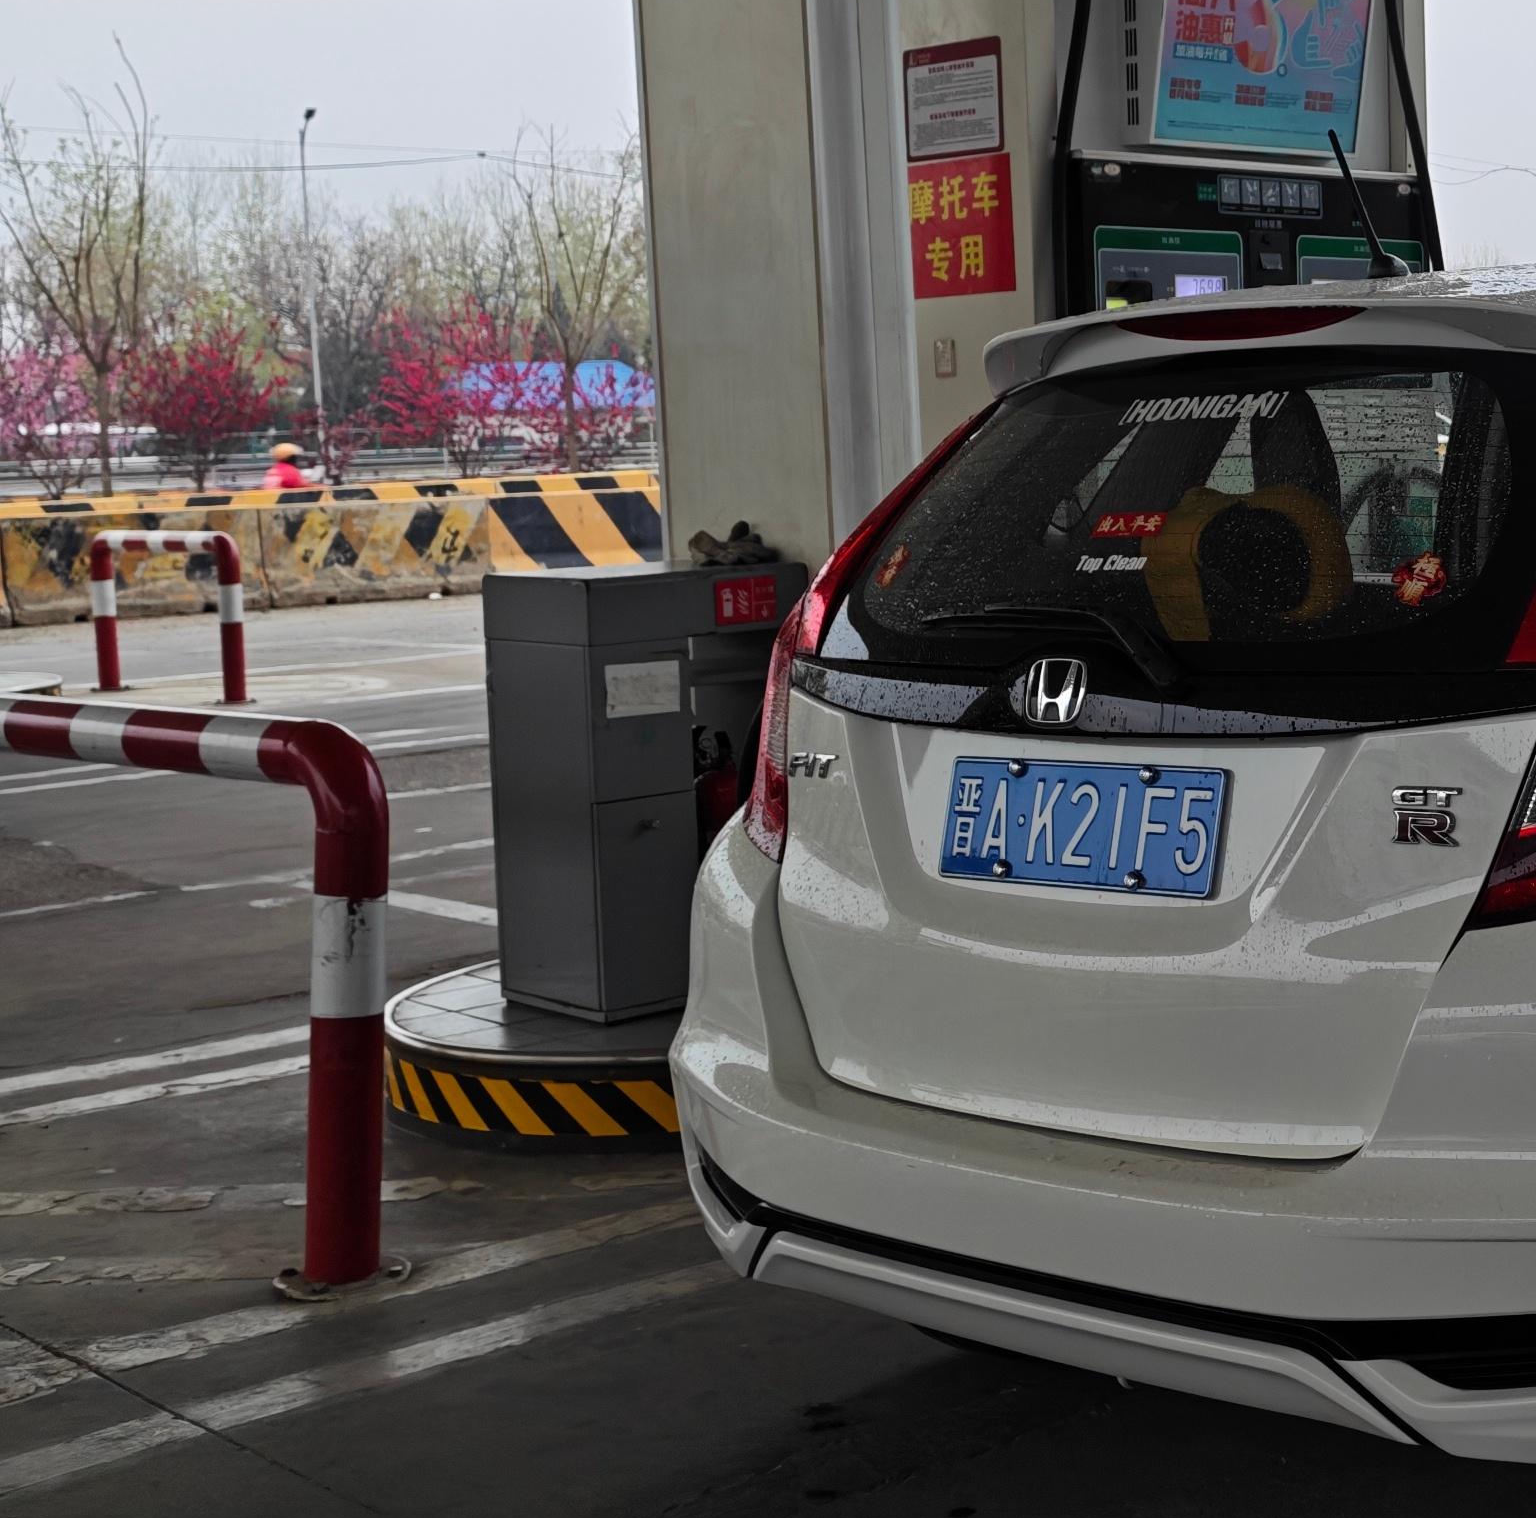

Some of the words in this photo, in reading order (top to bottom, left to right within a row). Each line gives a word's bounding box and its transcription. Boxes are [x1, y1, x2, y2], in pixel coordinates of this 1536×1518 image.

[908, 170, 1000, 226] 摩托车
[925, 234, 986, 282] 专用
[1096, 514, 1162, 532] 出入平安
[1075, 554, 1100, 574] Top
[1102, 554, 1148, 571] Clean
[788, 751, 840, 779] FIT
[1391, 785, 1463, 808] GT
[1391, 808, 1460, 847] R
